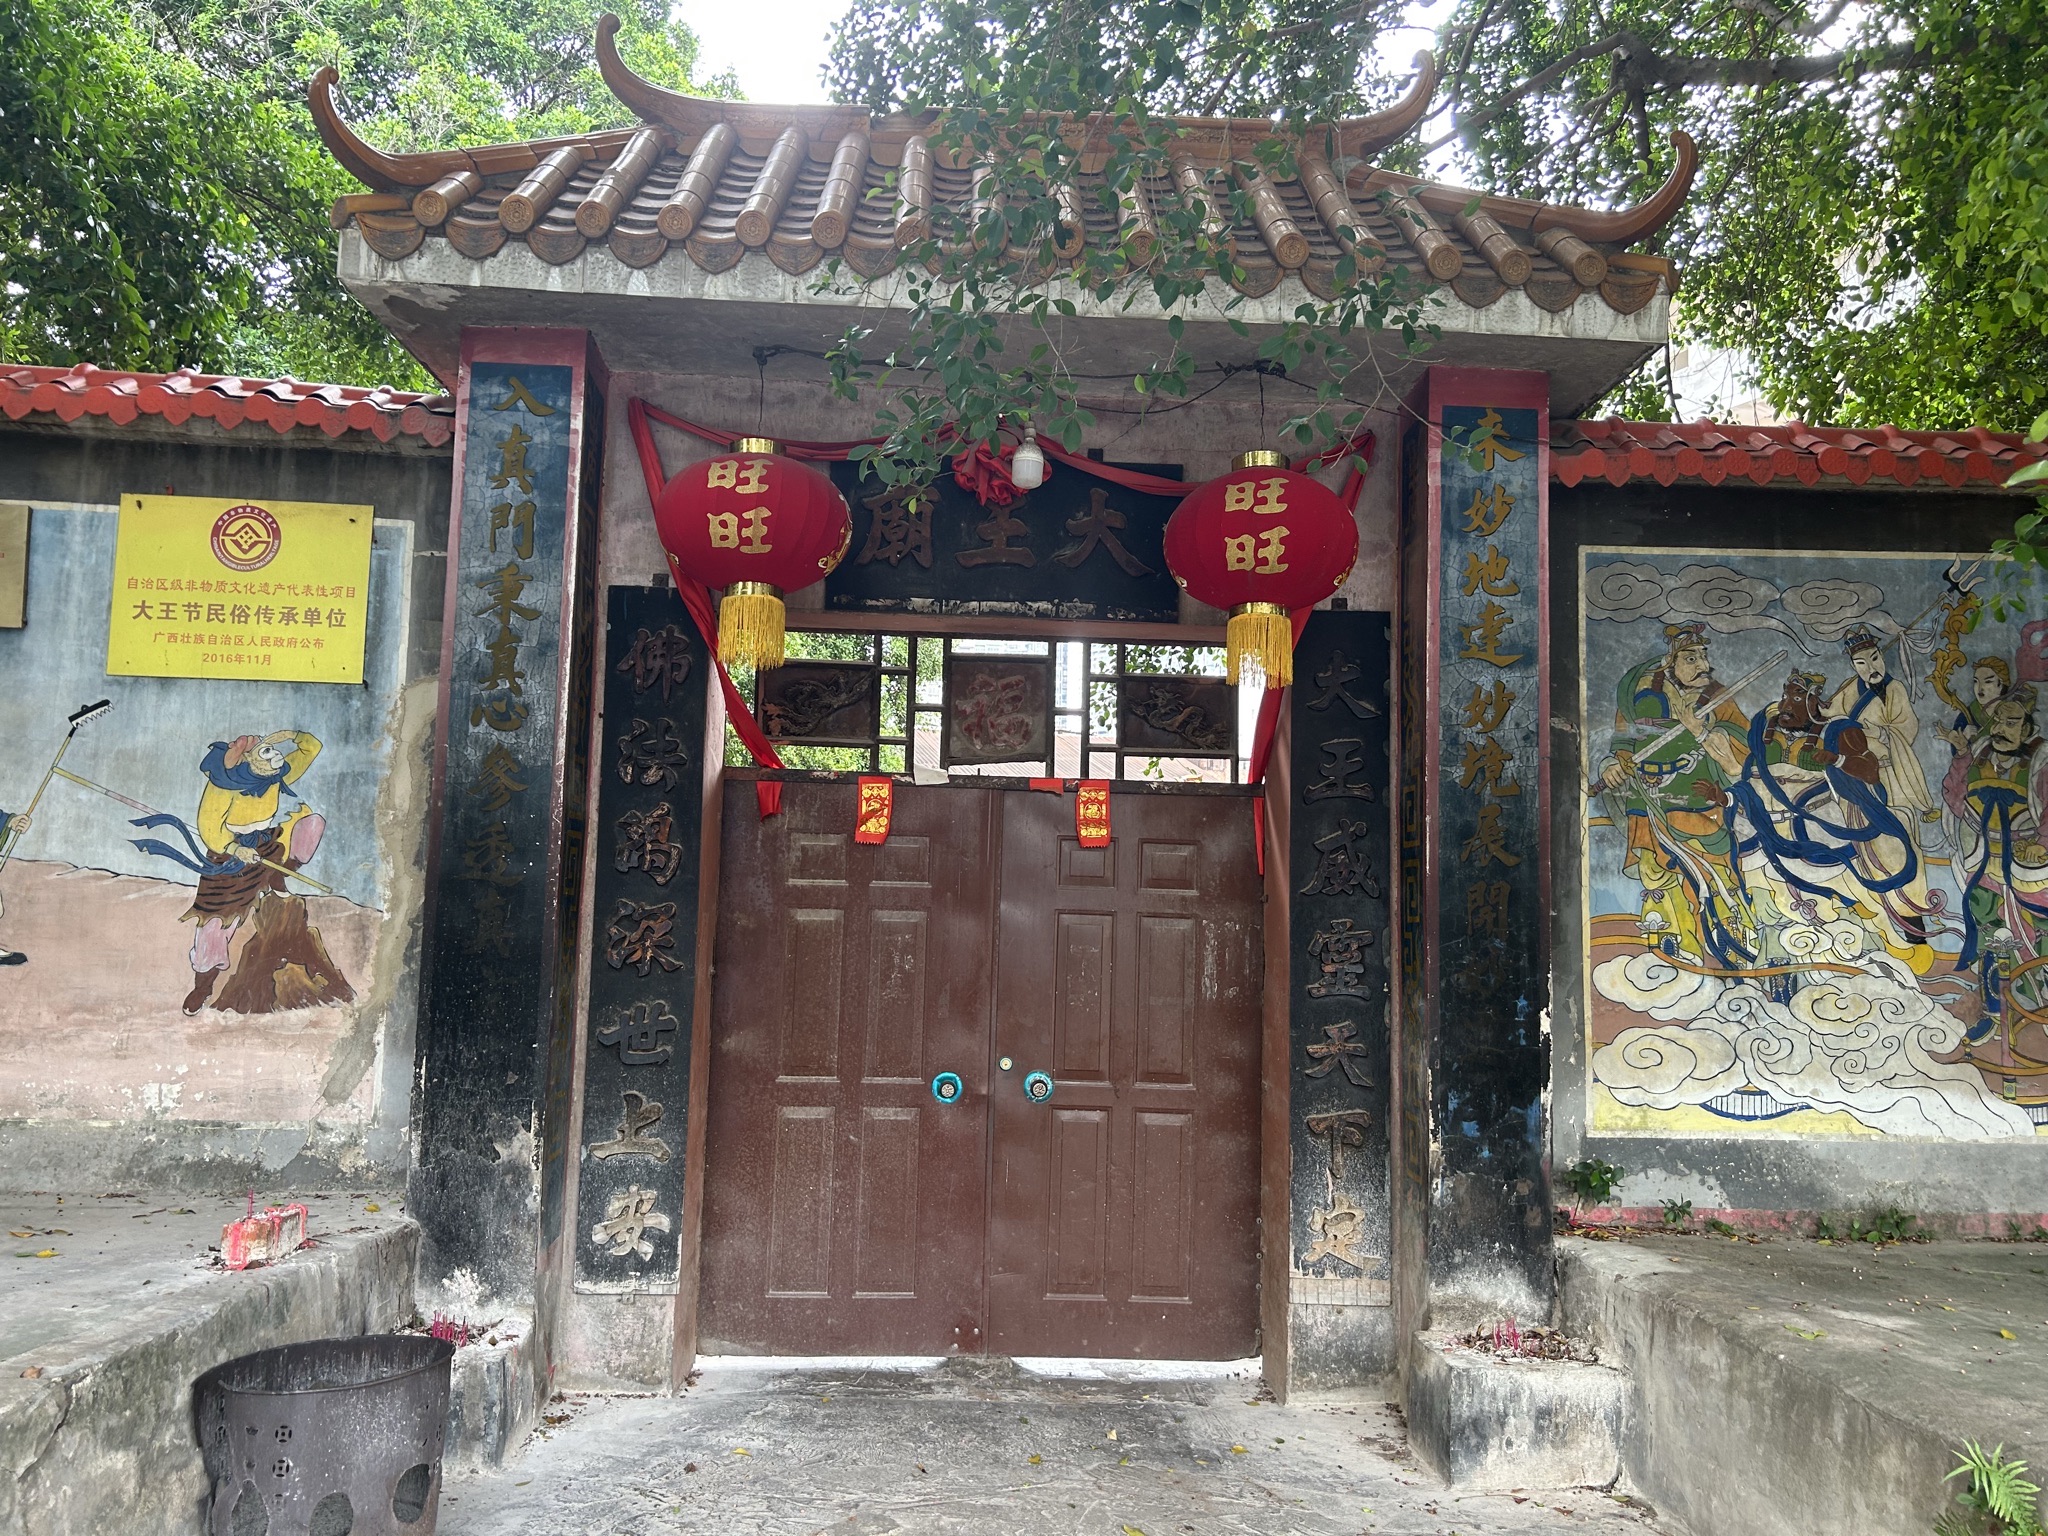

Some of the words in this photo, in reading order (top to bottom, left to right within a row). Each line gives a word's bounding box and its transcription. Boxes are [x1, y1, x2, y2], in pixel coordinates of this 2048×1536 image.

[707, 458, 774, 554] 旺旺
[1224, 477, 1290, 575] 旺旺
[127, 577, 356, 598] 自治区级非物质文化遗产代表性项目
[132, 599, 347, 628] 大王节民俗传承单位
[152, 631, 325, 650] 广西壮族自治区人民政府公布
[202, 652, 272, 666] 2016年11月
